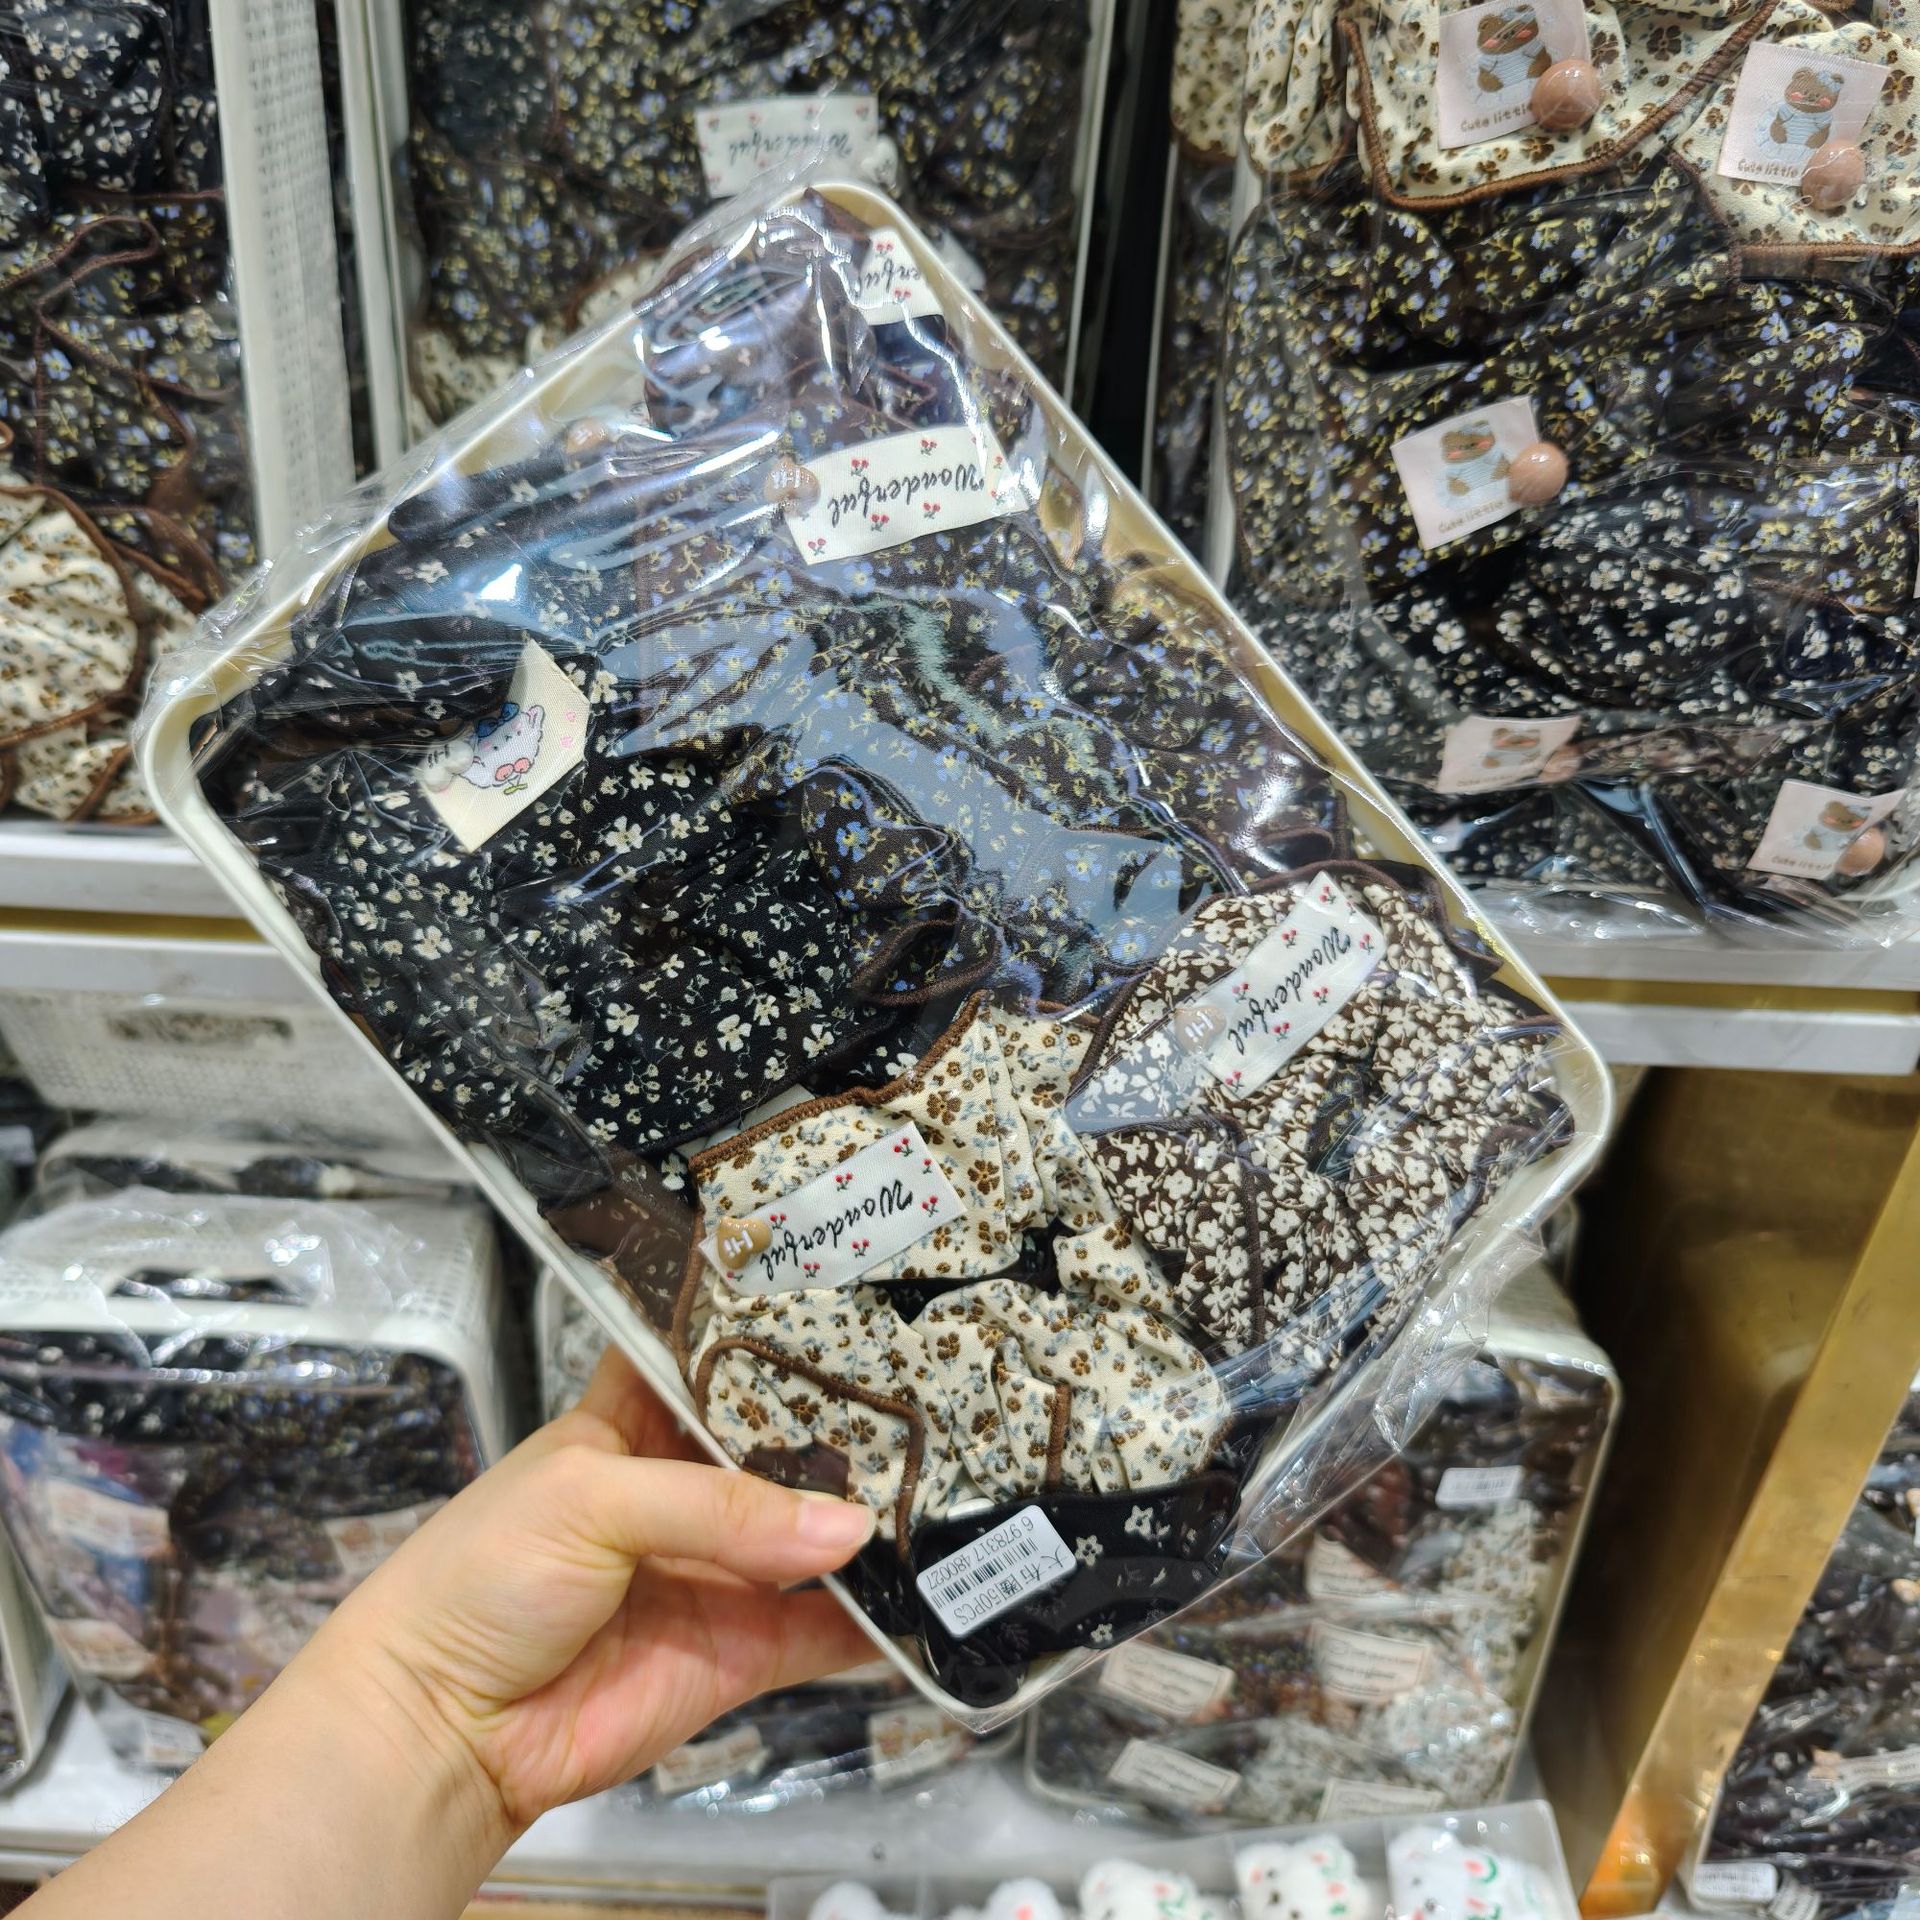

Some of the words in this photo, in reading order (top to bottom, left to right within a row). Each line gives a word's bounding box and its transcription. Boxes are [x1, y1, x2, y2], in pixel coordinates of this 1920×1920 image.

[727, 128, 853, 167] Wnderful
[827, 462, 987, 527] Wonderful
[1227, 926, 1351, 1055] Wonderful
[1183, 1012, 1215, 1041] Hi
[722, 1229, 754, 1258] Hi
[759, 1179, 914, 1281] Wonderful
[973, 1523, 1023, 1562] 978317
[1020, 1515, 1034, 1532] 6
[927, 1556, 972, 1590] 480027
[953, 1544, 1064, 1626] 大布圈50PCS
